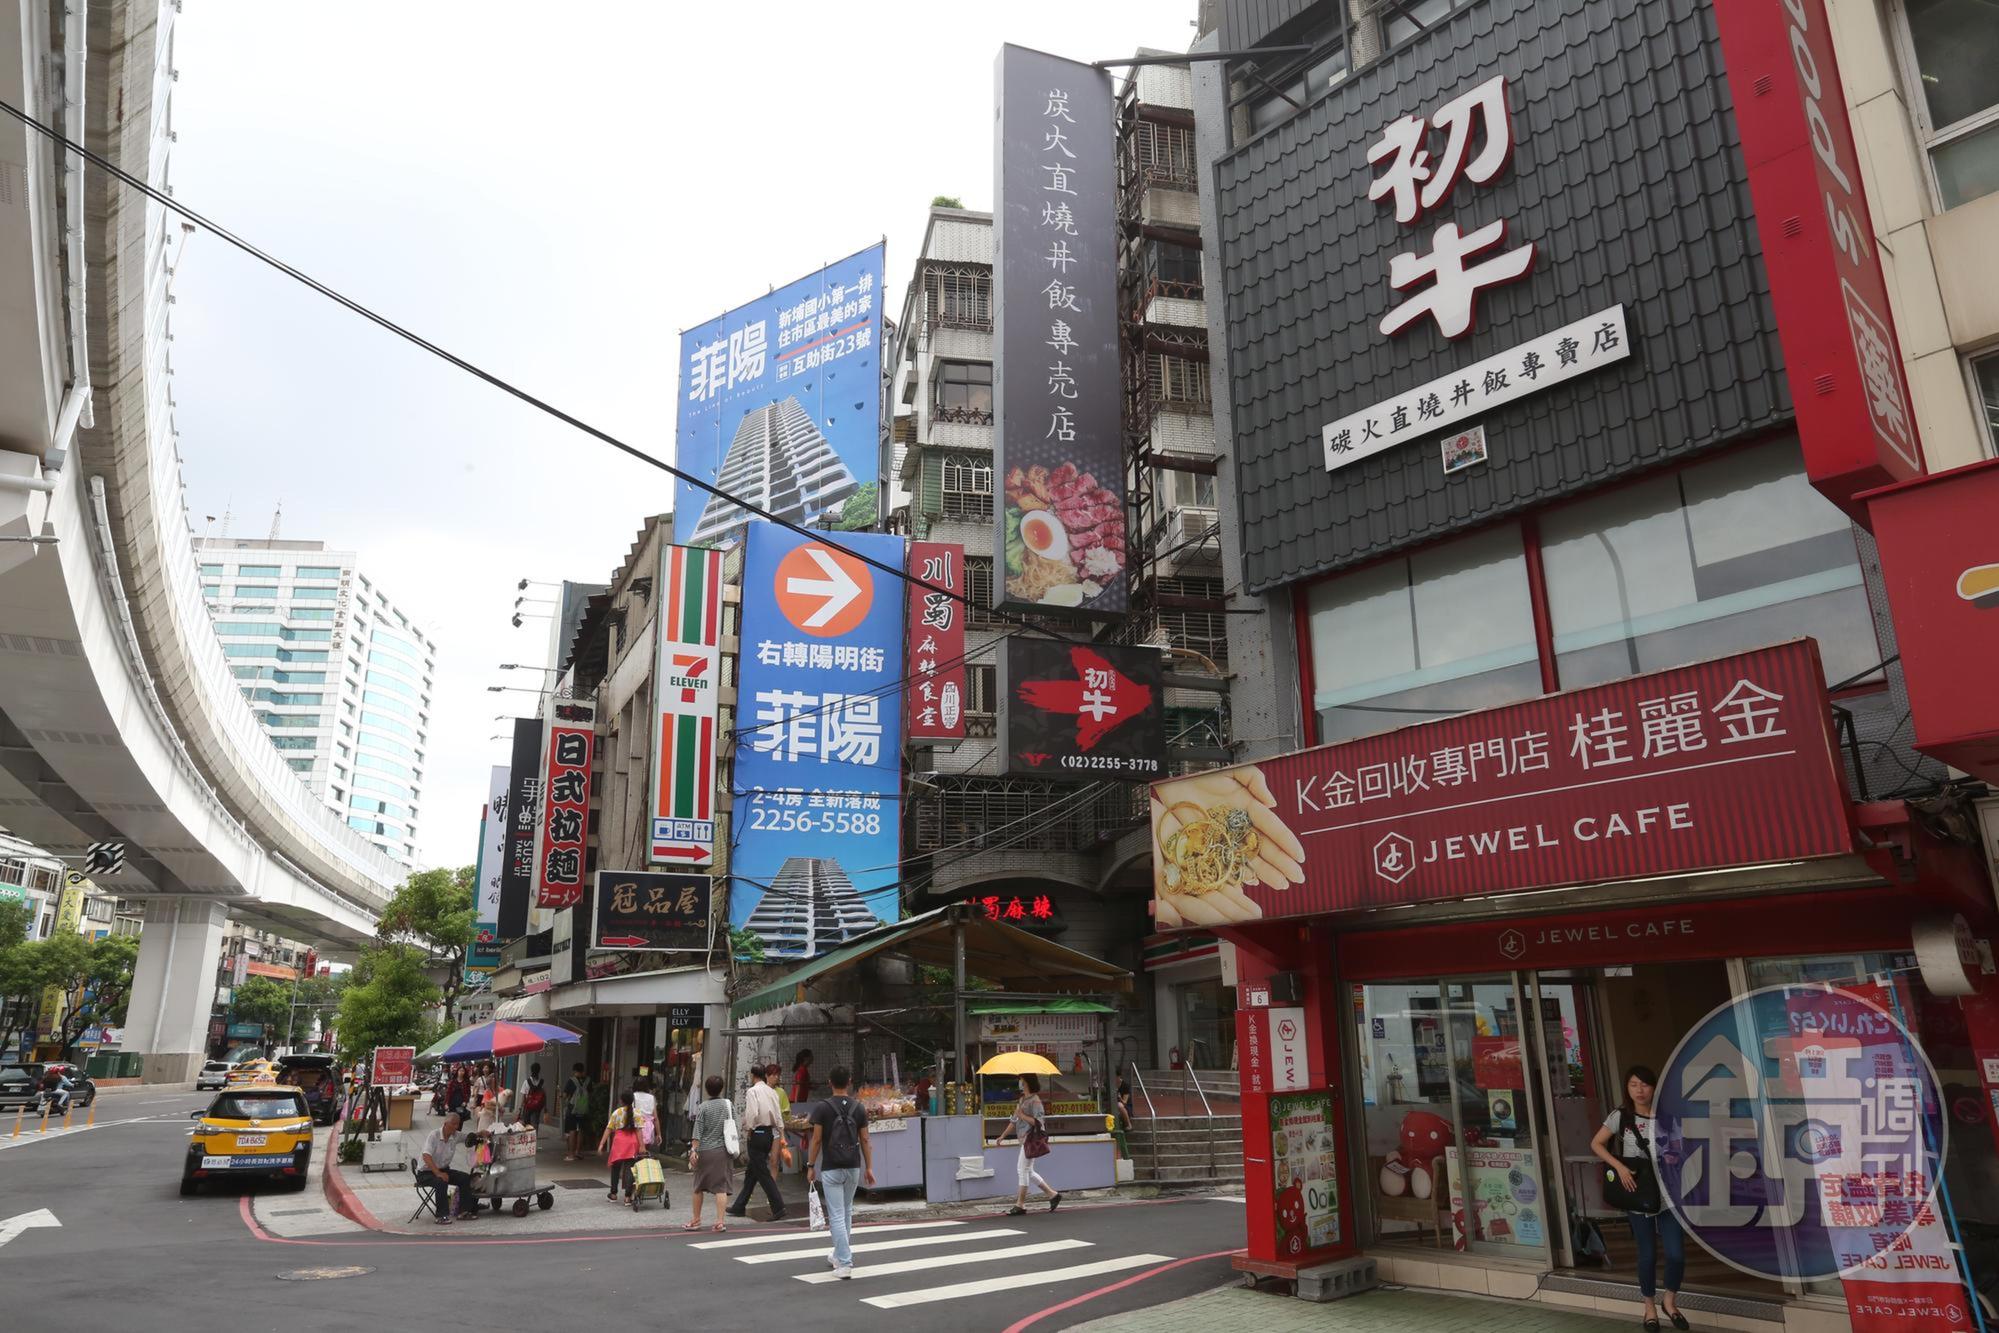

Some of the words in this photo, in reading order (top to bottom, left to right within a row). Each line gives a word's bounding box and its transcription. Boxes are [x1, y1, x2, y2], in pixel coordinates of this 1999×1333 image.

[1367, 75, 1535, 339] 初牛
[778, 273, 873, 328] 新埔國小第一排
[778, 295, 872, 349] 住市區最美的家
[689, 320, 768, 402] 菲陽
[792, 327, 872, 377] 互助街23號
[1330, 320, 1622, 455] 碳火直燒丼飯專賣店
[672, 653, 708, 704] 7
[757, 640, 884, 672] 右轉陽明街
[1079, 667, 1118, 722] 初牛
[752, 689, 883, 766] 菲陽
[1295, 731, 1550, 815] K金回收專門店
[1568, 678, 1789, 771] 桂麗金
[1060, 755, 1158, 771] (02)2255-3778
[545, 732, 588, 885] 日式拉麵
[750, 808, 880, 836] 2256-5588
[752, 785, 806, 807] 2-4房
[808, 787, 880, 811] 全新落成
[1423, 823, 1559, 863] JEWEL
[1573, 803, 1694, 842] CAFE
[521, 840, 533, 877] SUSHI
[541, 887, 581, 905] ラーメン
[610, 883, 699, 915] 冠品屋
[1536, 926, 1618, 944] JEWEL
[1627, 920, 1695, 938] CAFE
[672, 1008, 689, 1016] ELLY
[672, 1018, 689, 1026] ELLY
[1257, 994, 1263, 1004] 6
